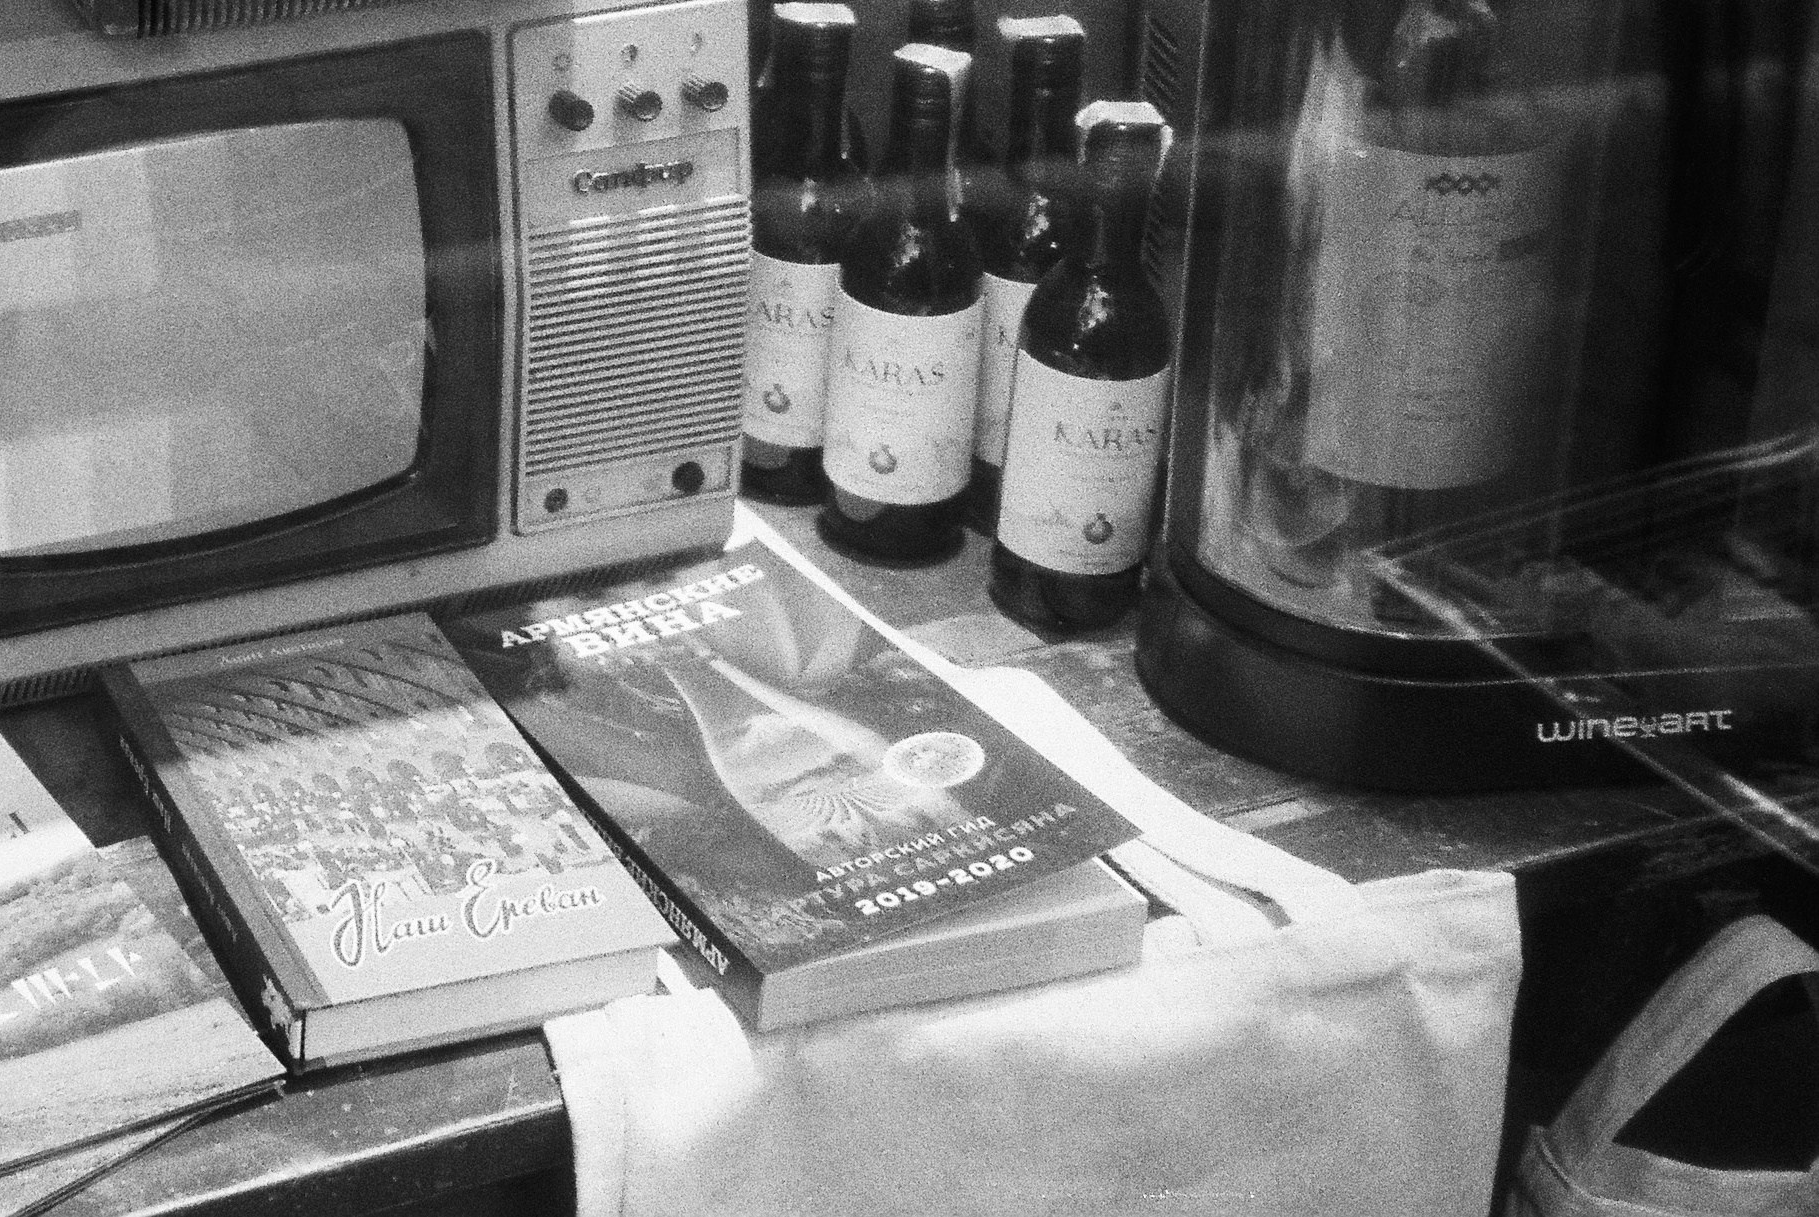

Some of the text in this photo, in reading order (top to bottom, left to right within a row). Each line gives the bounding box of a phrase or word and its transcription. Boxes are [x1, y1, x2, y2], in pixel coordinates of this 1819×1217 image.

[501, 563, 765, 649] АРМЯНСКИЕ
[560, 600, 744, 659] ВИНА
[816, 814, 996, 883] АВТОРСКИЙ ГИД
[854, 845, 1035, 916] 2019-2020
[327, 874, 452, 970] Наш
[457, 858, 604, 940] Ереван
